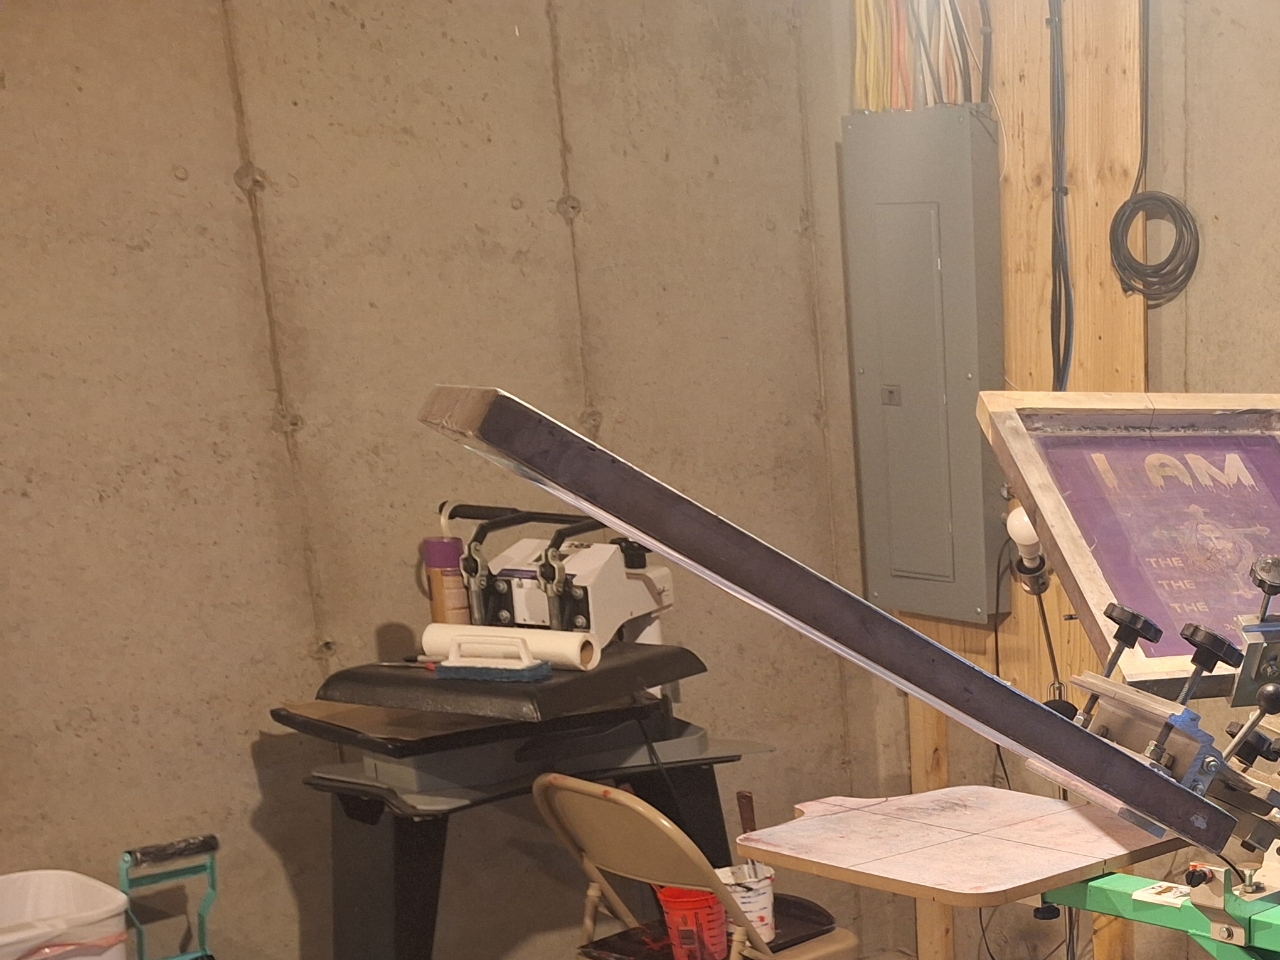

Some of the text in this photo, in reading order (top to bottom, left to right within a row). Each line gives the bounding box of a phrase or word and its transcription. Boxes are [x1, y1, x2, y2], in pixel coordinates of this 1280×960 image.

[1091, 453, 1259, 493] I AM
[1146, 557, 1184, 568] THE
[1158, 580, 1196, 590] THE
[1170, 602, 1209, 613] THE
